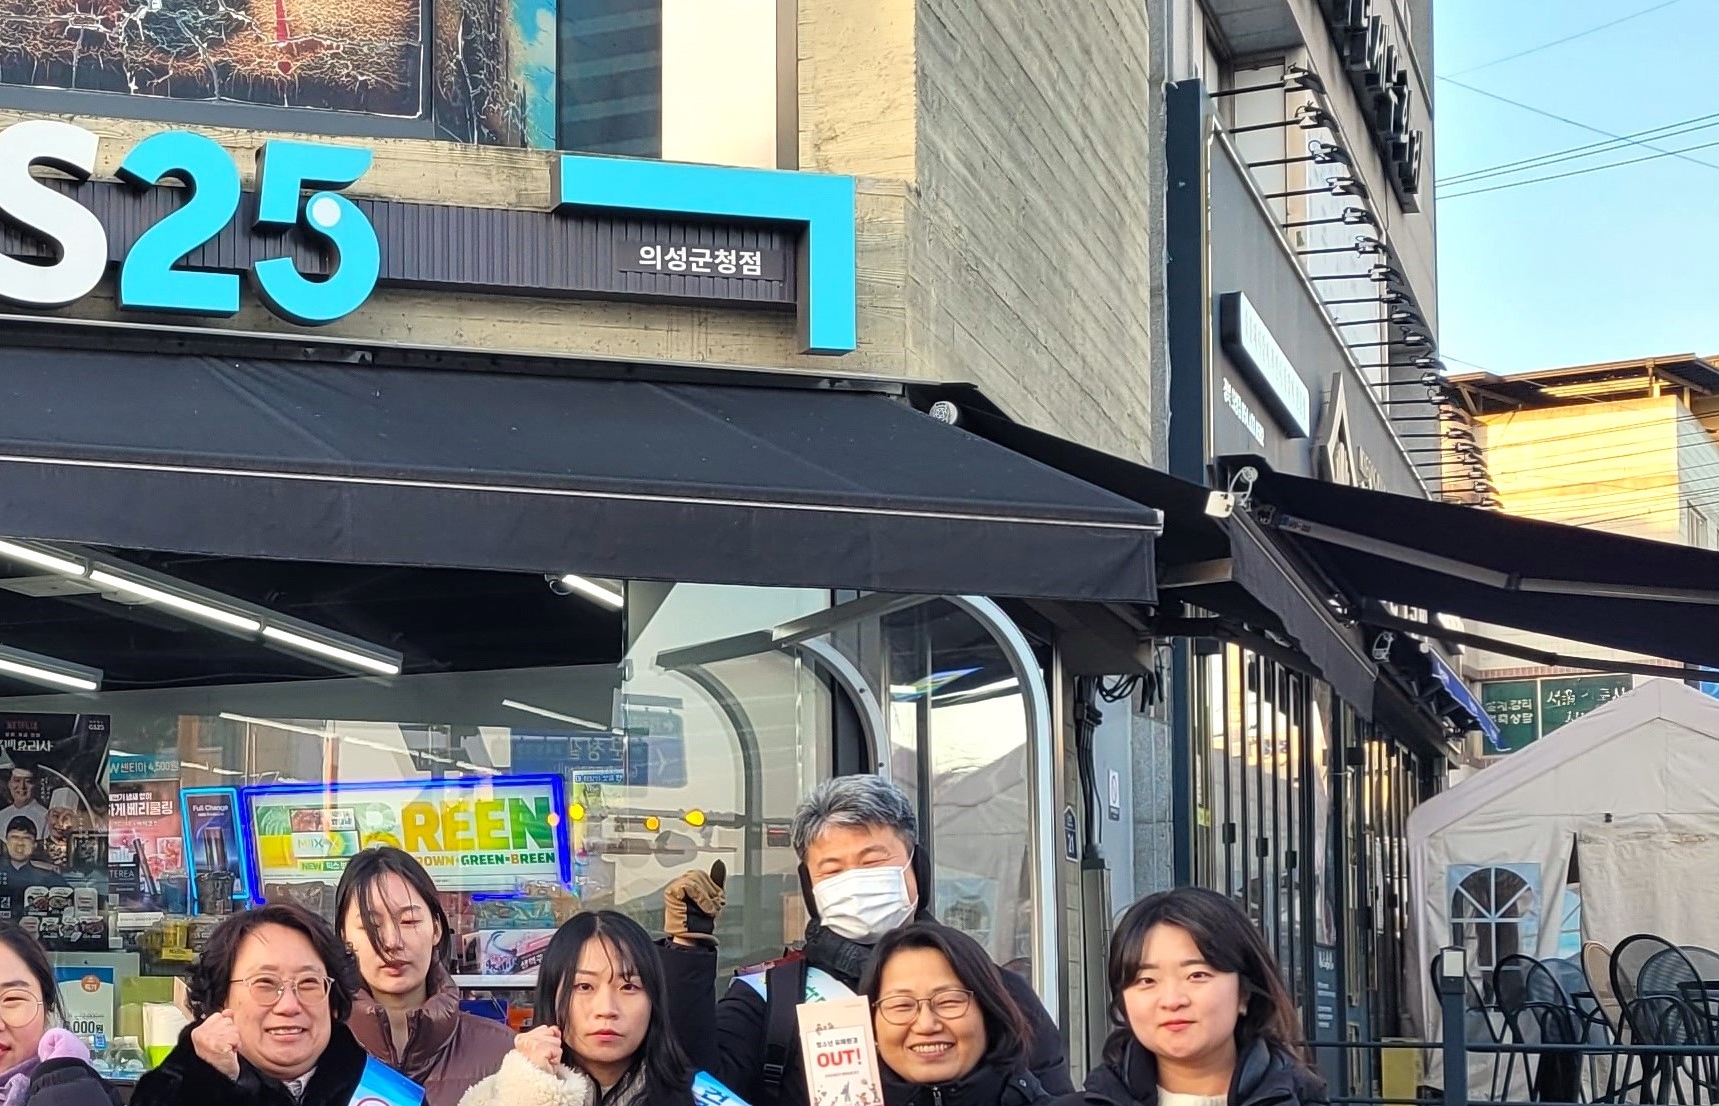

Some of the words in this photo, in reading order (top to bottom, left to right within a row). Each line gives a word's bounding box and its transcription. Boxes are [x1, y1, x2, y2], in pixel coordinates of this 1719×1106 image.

[639, 245, 762, 276] 의성군청점
[109, 868, 135, 878] TEREA
[816, 1048, 862, 1068] OUT!
